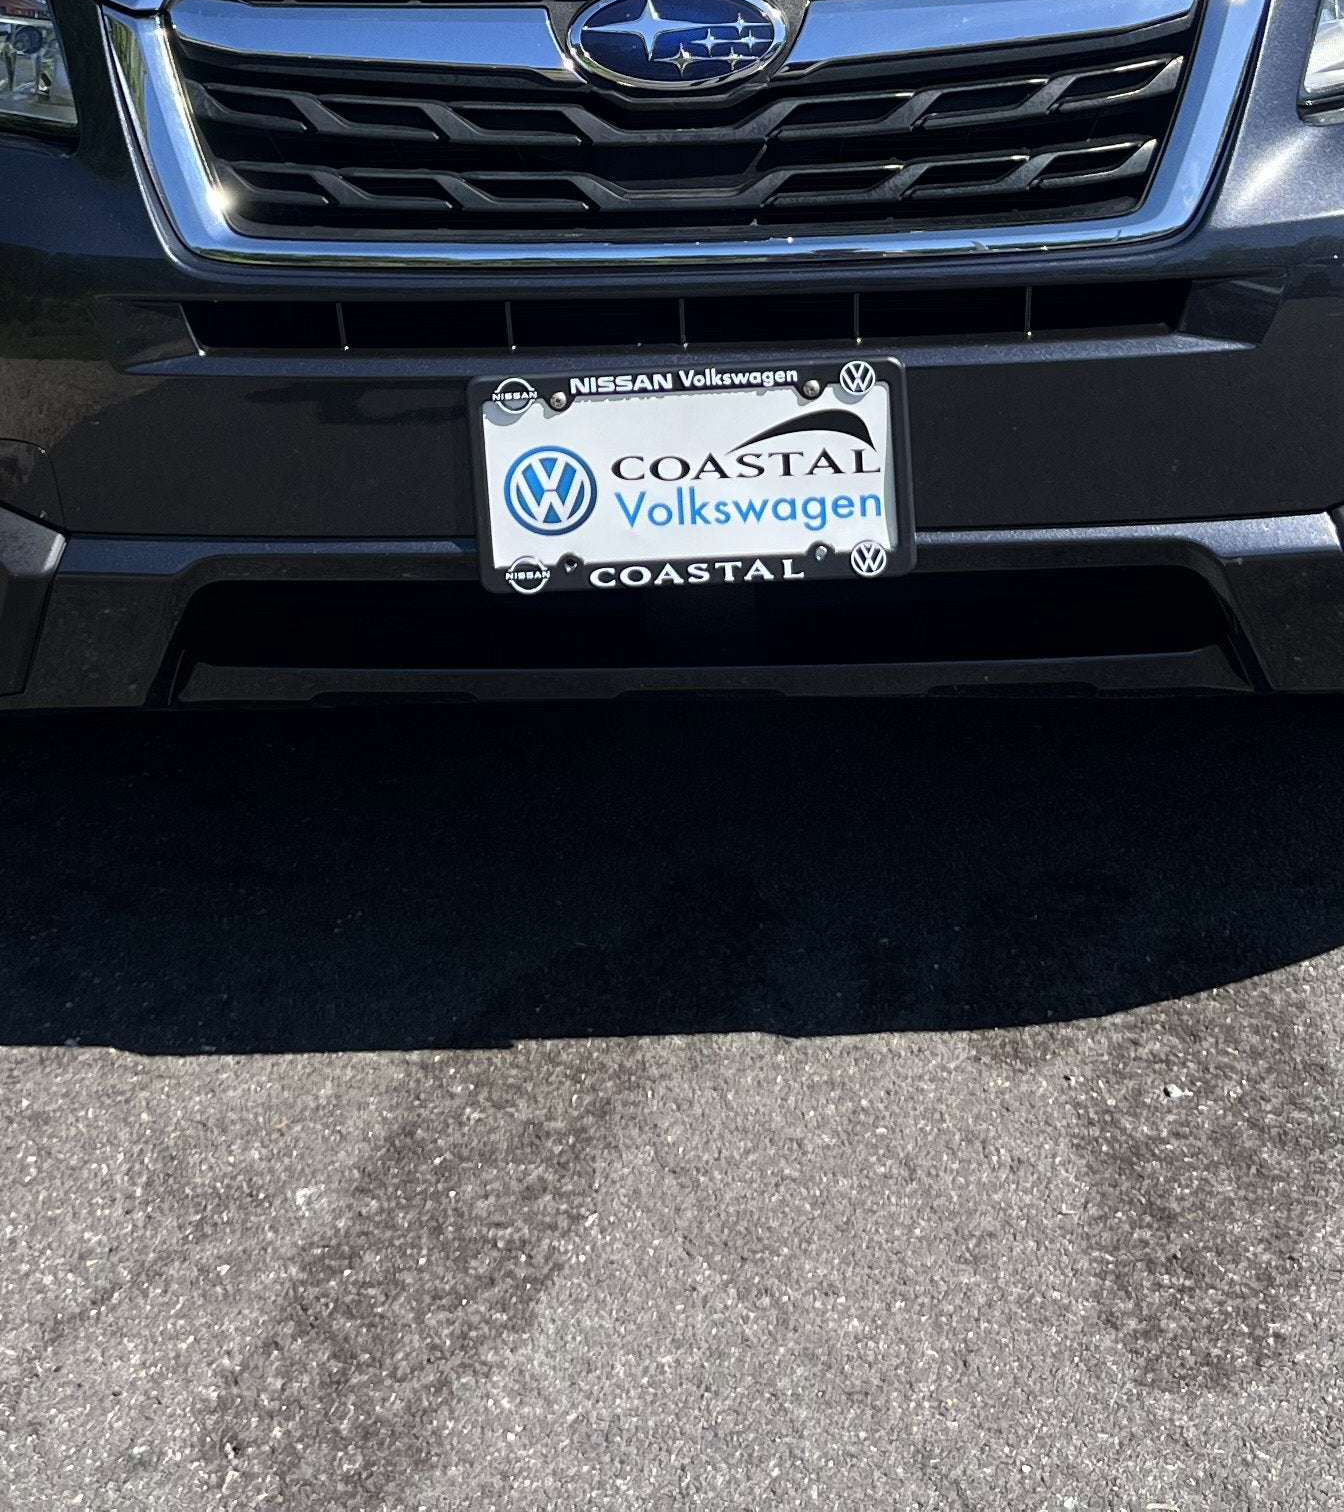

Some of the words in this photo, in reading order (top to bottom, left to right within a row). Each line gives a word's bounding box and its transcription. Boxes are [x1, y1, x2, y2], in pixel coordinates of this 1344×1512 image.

[569, 373, 672, 395] NISSAN
[679, 369, 798, 388] Volkswagen
[839, 360, 876, 395] VW
[492, 391, 537, 401] NISSAN
[611, 448, 881, 481] COASTAL
[504, 445, 597, 535] VW
[614, 486, 882, 531] Volkswagen
[590, 558, 805, 588] COASTAL
[851, 540, 887, 576] VW
[505, 570, 551, 581] NISSAN
